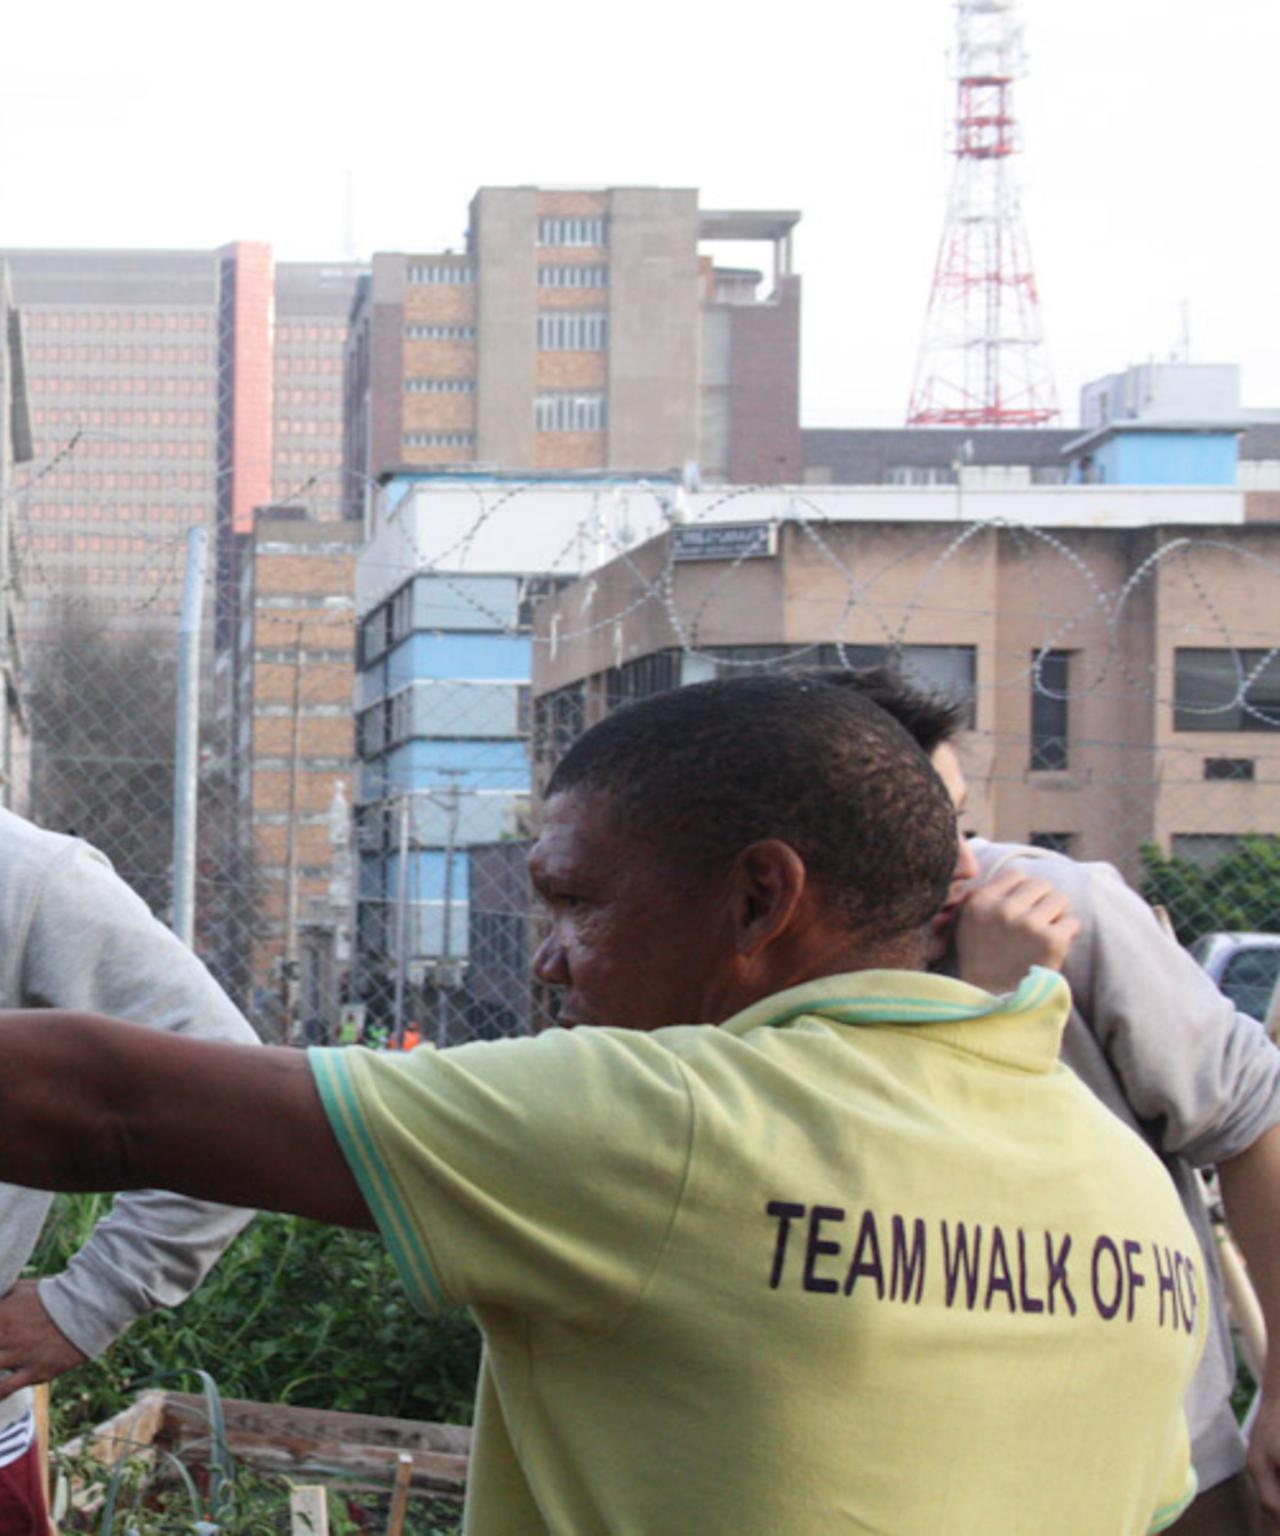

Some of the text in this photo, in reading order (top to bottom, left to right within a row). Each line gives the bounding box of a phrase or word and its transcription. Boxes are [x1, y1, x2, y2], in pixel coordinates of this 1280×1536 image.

[766, 1200, 926, 1304] TEAM
[940, 1219, 1077, 1317] WALK
[1091, 1234, 1145, 1323] OF
